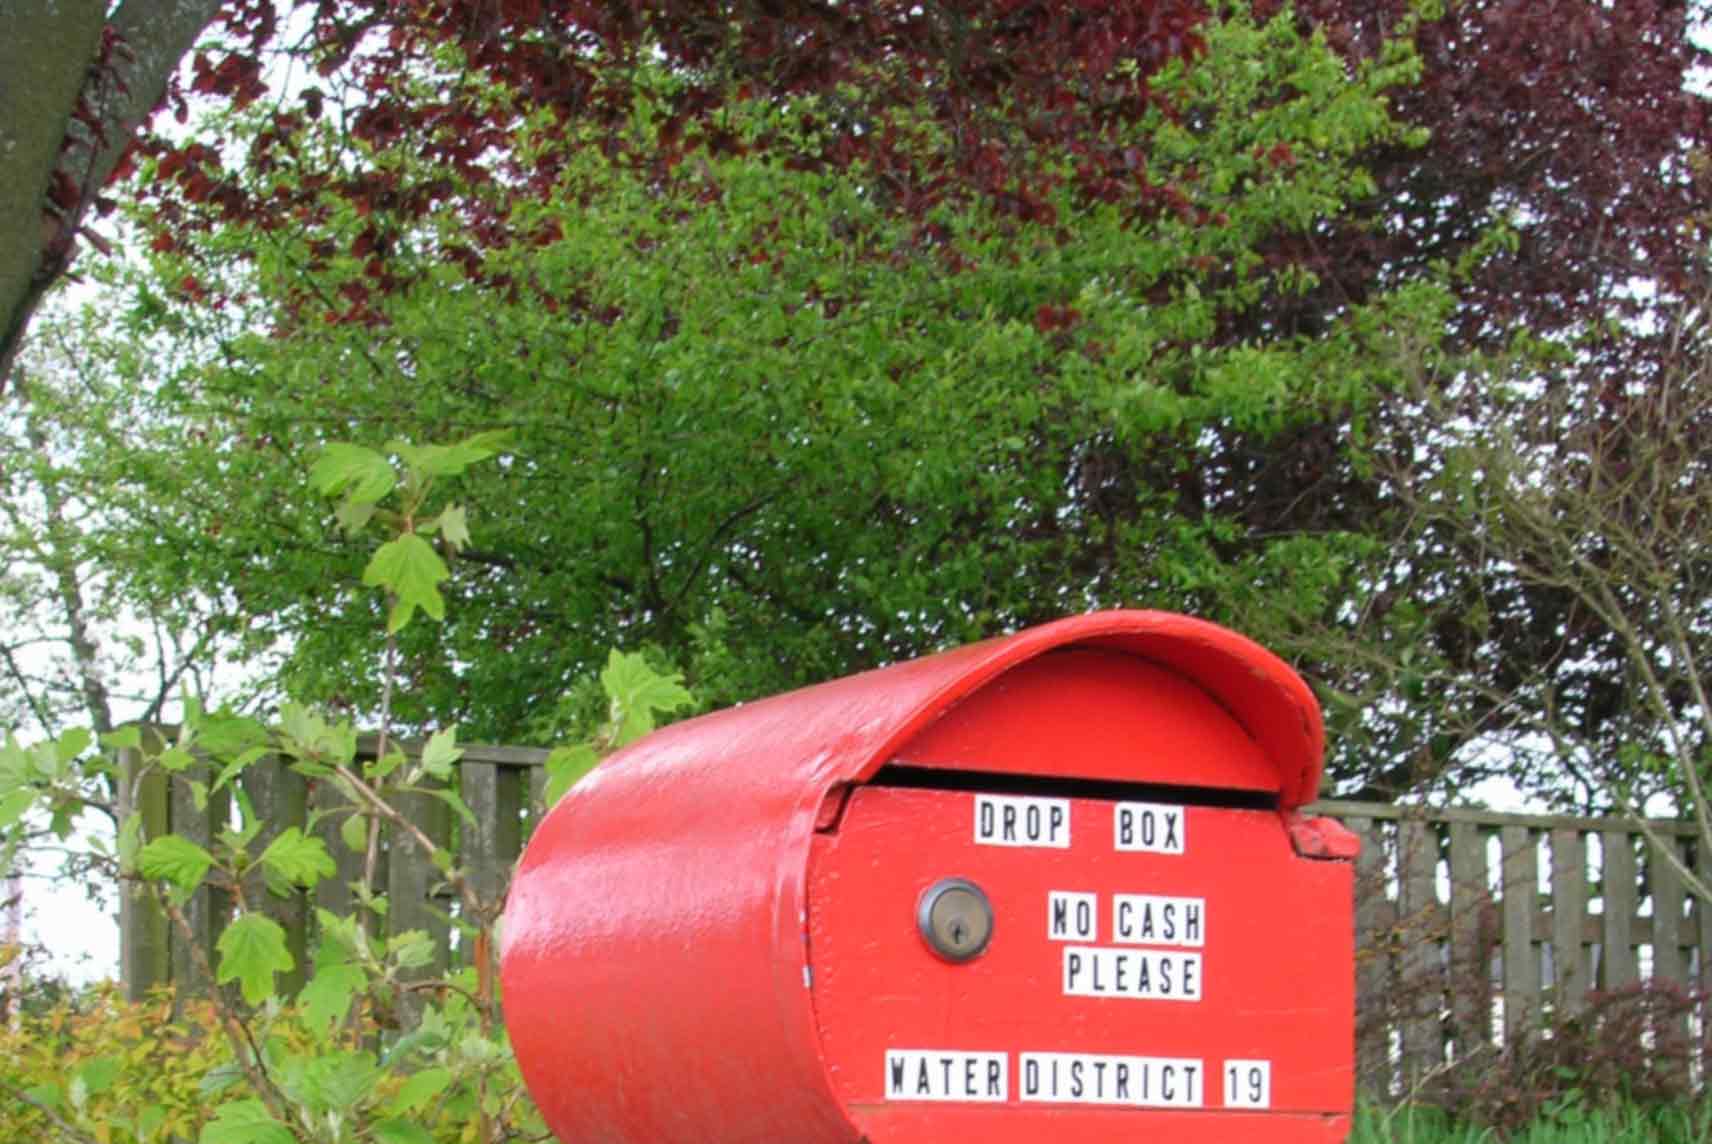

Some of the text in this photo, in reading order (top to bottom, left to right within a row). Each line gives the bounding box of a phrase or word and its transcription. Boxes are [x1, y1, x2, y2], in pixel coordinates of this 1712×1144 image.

[979, 801, 1179, 849] DROP BOX
[1053, 897, 1200, 942] NO CASH
[1068, 953, 1196, 995] PLEASE
[890, 1057, 1263, 1103] WATER DISTRICT 19
